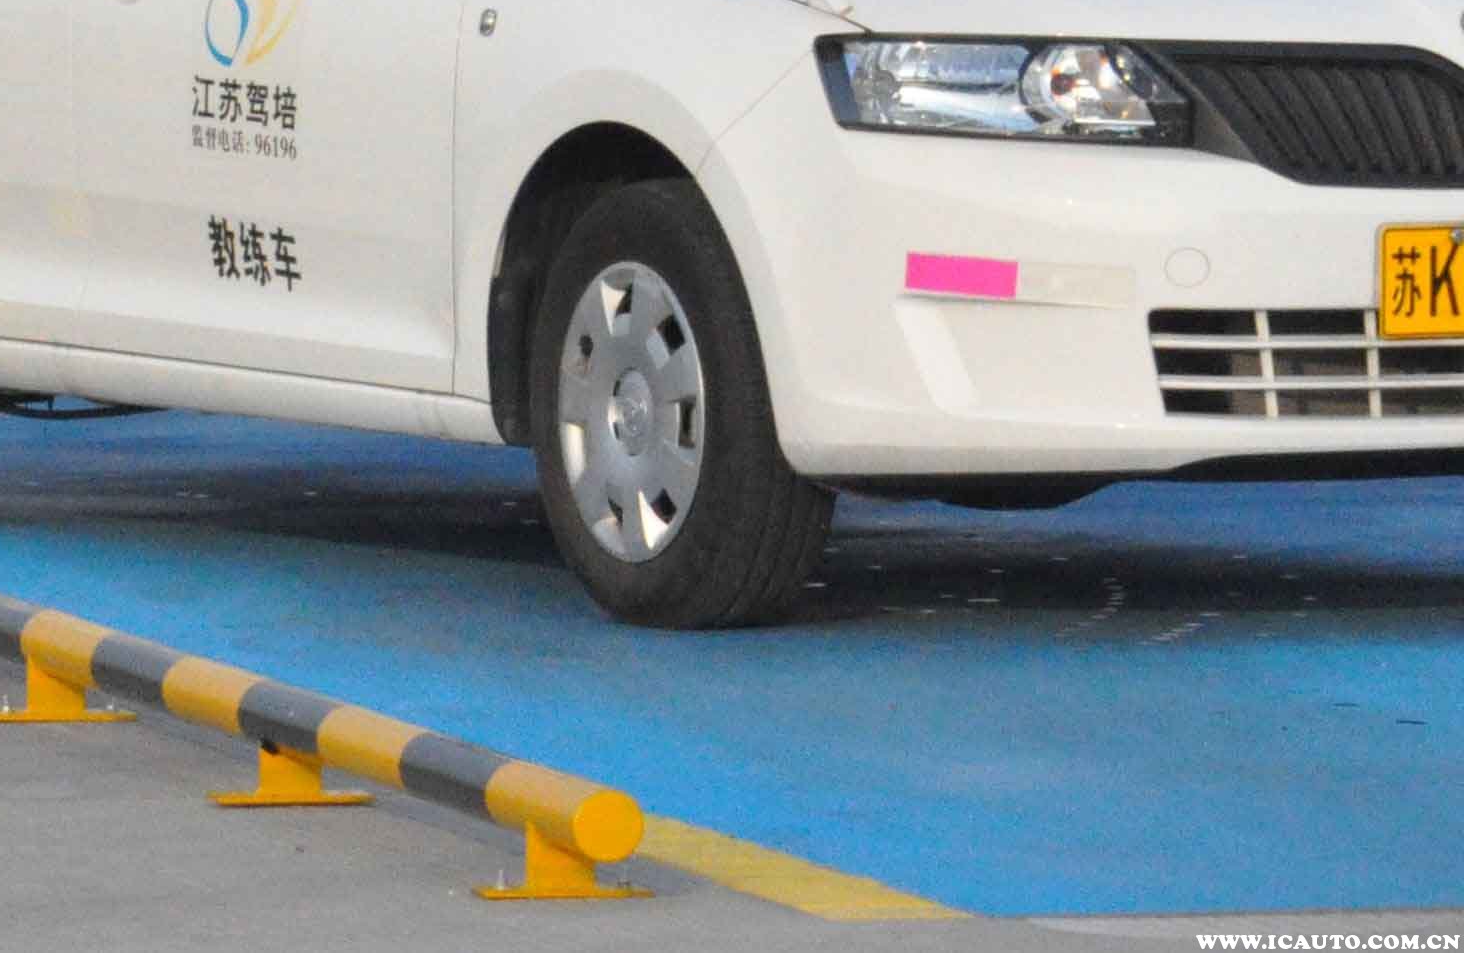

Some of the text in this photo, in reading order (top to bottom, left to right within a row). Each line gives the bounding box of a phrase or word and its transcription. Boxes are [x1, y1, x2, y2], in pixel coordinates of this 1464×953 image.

[192, 76, 297, 130] 江苏驾培
[208, 214, 302, 292] 教练车
[1392, 244, 1460, 317] 苏K
